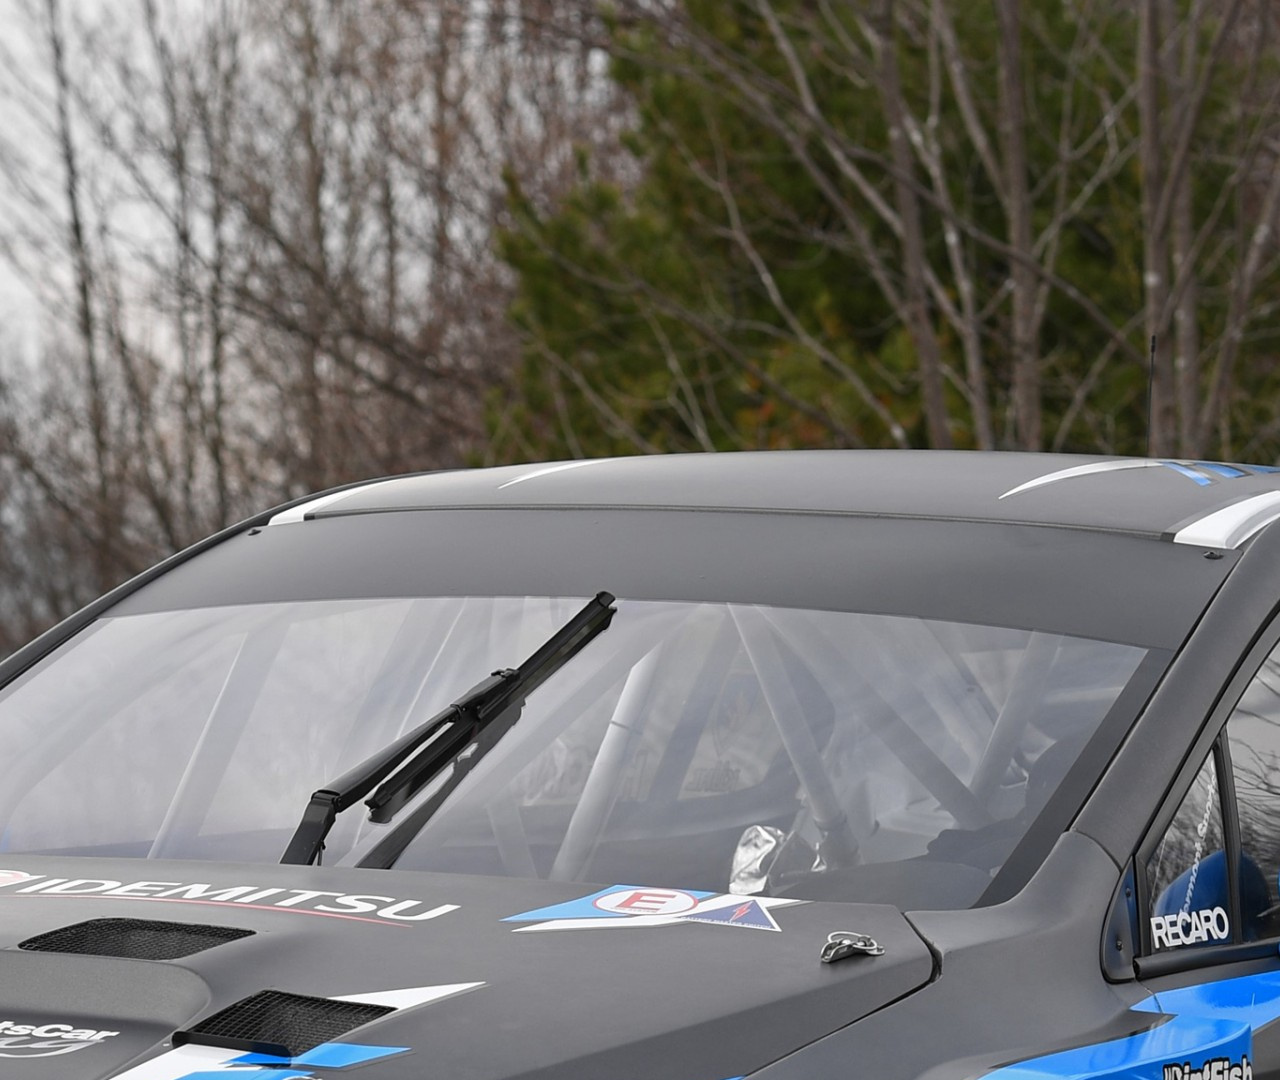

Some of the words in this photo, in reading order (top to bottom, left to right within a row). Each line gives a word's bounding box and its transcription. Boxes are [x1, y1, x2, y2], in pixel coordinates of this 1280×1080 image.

[17, 872, 462, 922] IDEMITSU
[616, 892, 676, 910] E
[1150, 906, 1230, 949] RECARO
